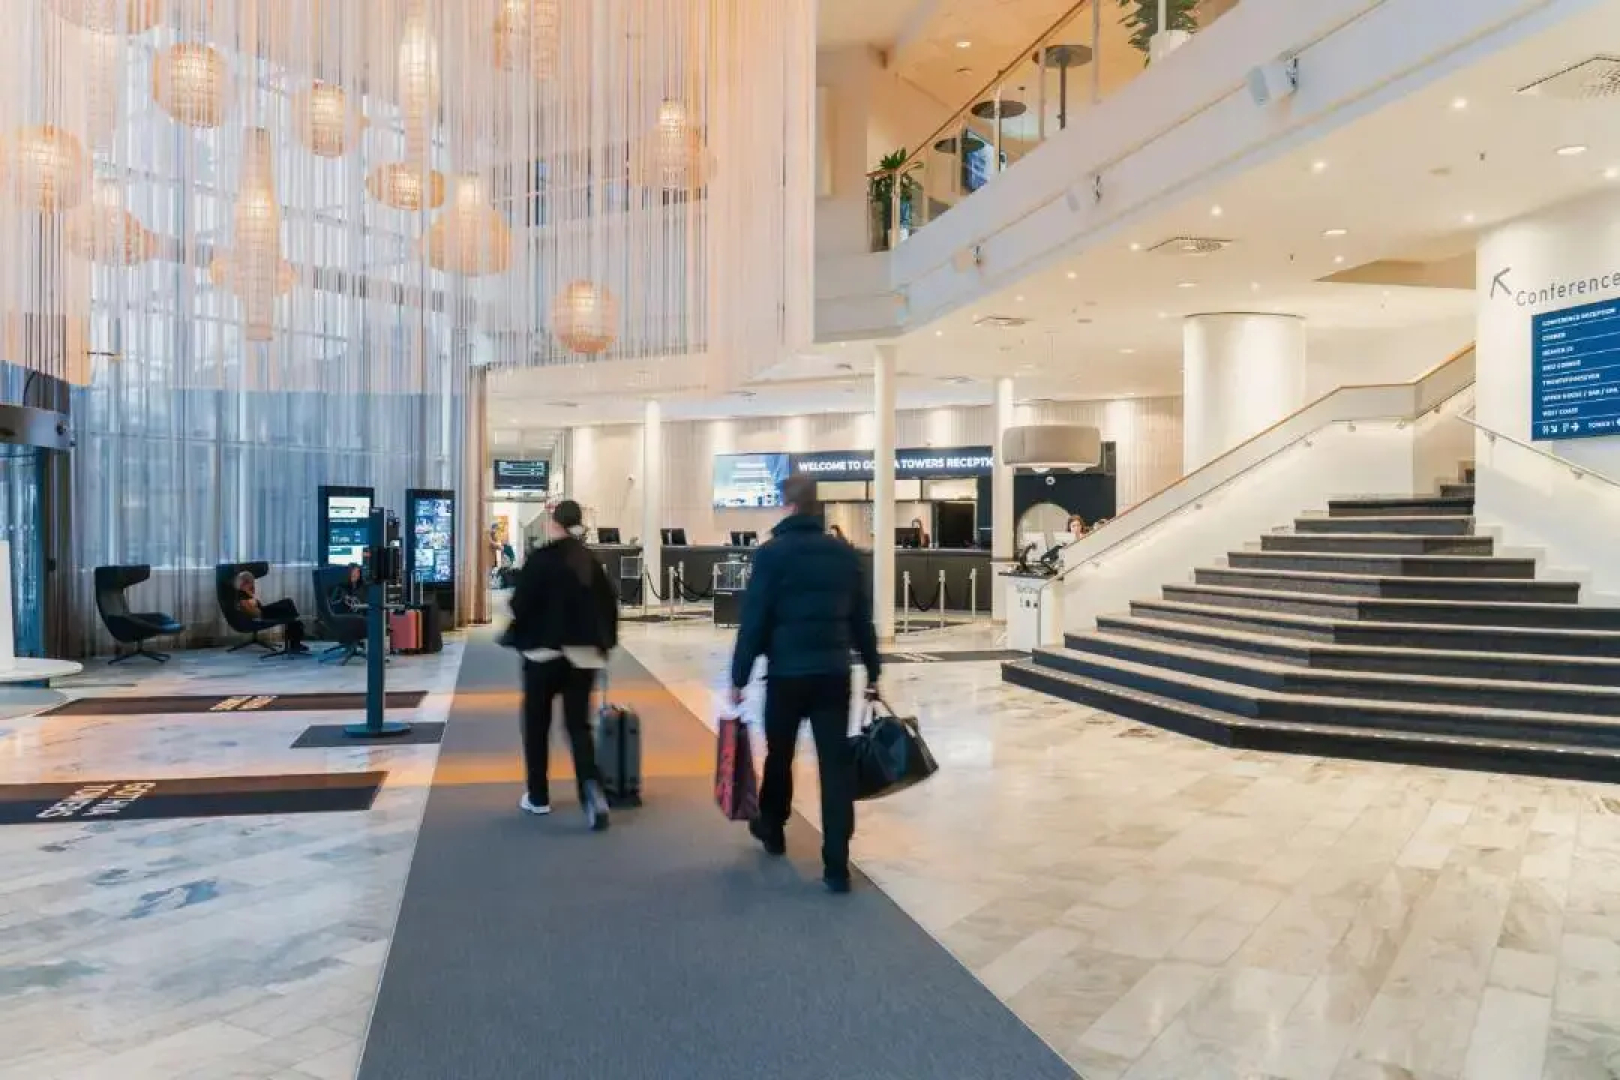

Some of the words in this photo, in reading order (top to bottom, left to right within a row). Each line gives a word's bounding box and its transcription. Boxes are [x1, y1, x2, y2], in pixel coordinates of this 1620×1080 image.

[1516, 272, 1620, 306] Conference
[798, 461, 847, 472] WELCOME
[848, 460, 862, 470] TO
[901, 458, 944, 469] TOWERS
